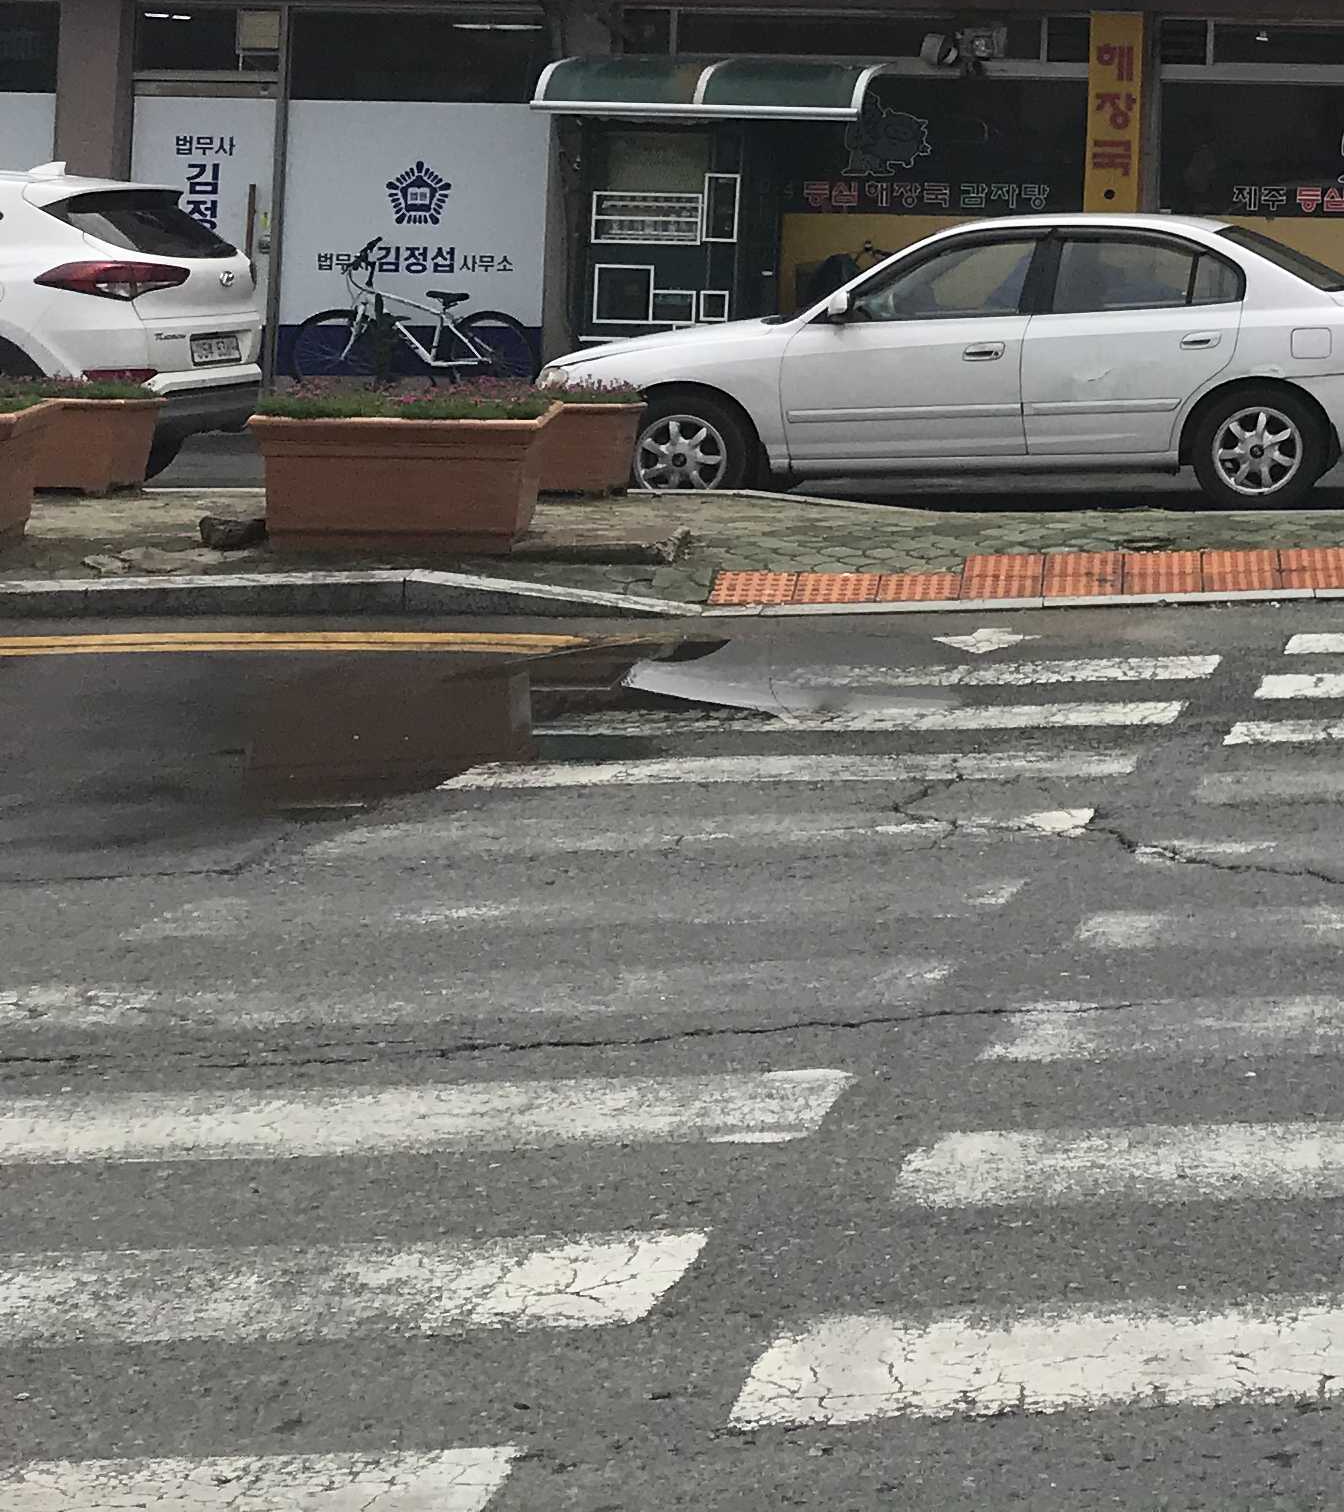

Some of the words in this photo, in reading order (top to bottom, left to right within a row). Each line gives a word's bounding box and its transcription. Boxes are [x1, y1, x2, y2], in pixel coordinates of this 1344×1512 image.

[1097, 43, 1136, 177] 해장국
[175, 136, 236, 157] 법무사
[960, 183, 1050, 210] 감자탕
[1232, 186, 1288, 212] 제주
[376, 245, 457, 274] 김정섭
[459, 254, 514, 273] 사무소
